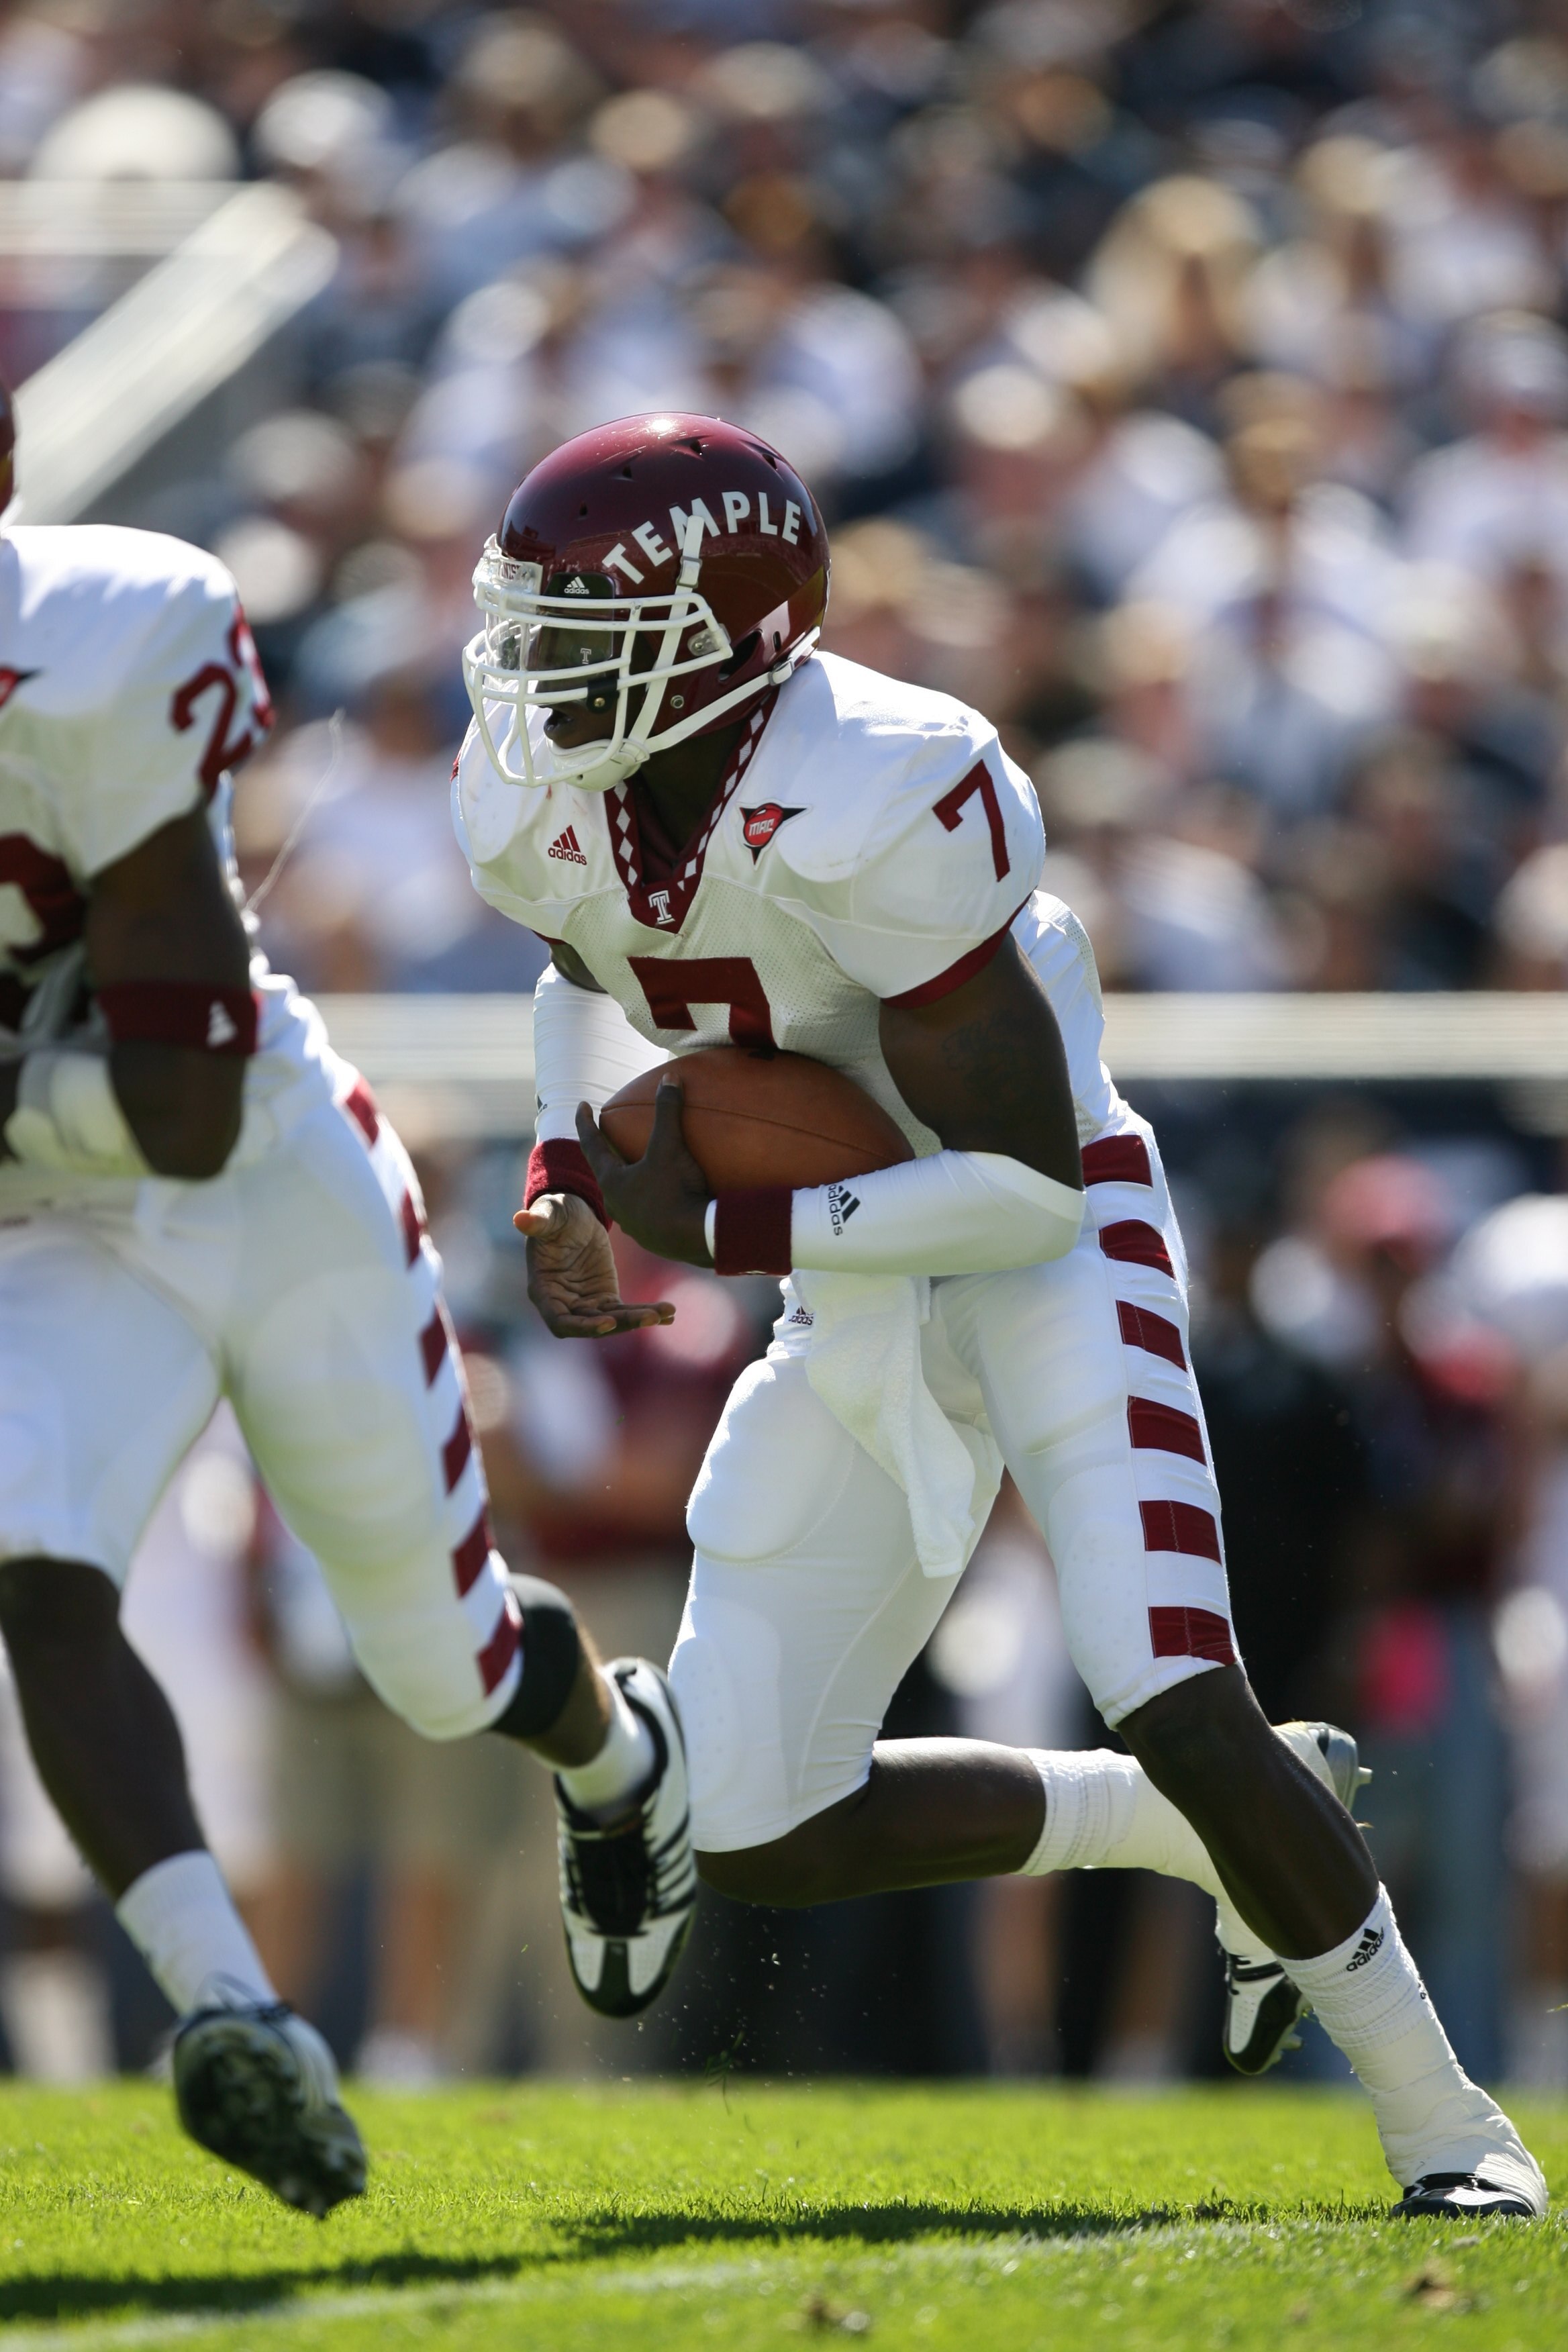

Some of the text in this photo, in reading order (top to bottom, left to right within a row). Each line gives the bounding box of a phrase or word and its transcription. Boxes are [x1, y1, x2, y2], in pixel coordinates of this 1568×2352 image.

[601, 491, 802, 585] TEMPLE
[564, 587, 589, 595] adidas
[580, 647, 592, 665] T
[748, 818, 775, 837] MAC
[932, 758, 1011, 883] 7
[548, 846, 587, 866] adidas
[648, 889, 676, 925] T
[626, 956, 779, 1050] 7
[828, 1183, 843, 1236] adidas
